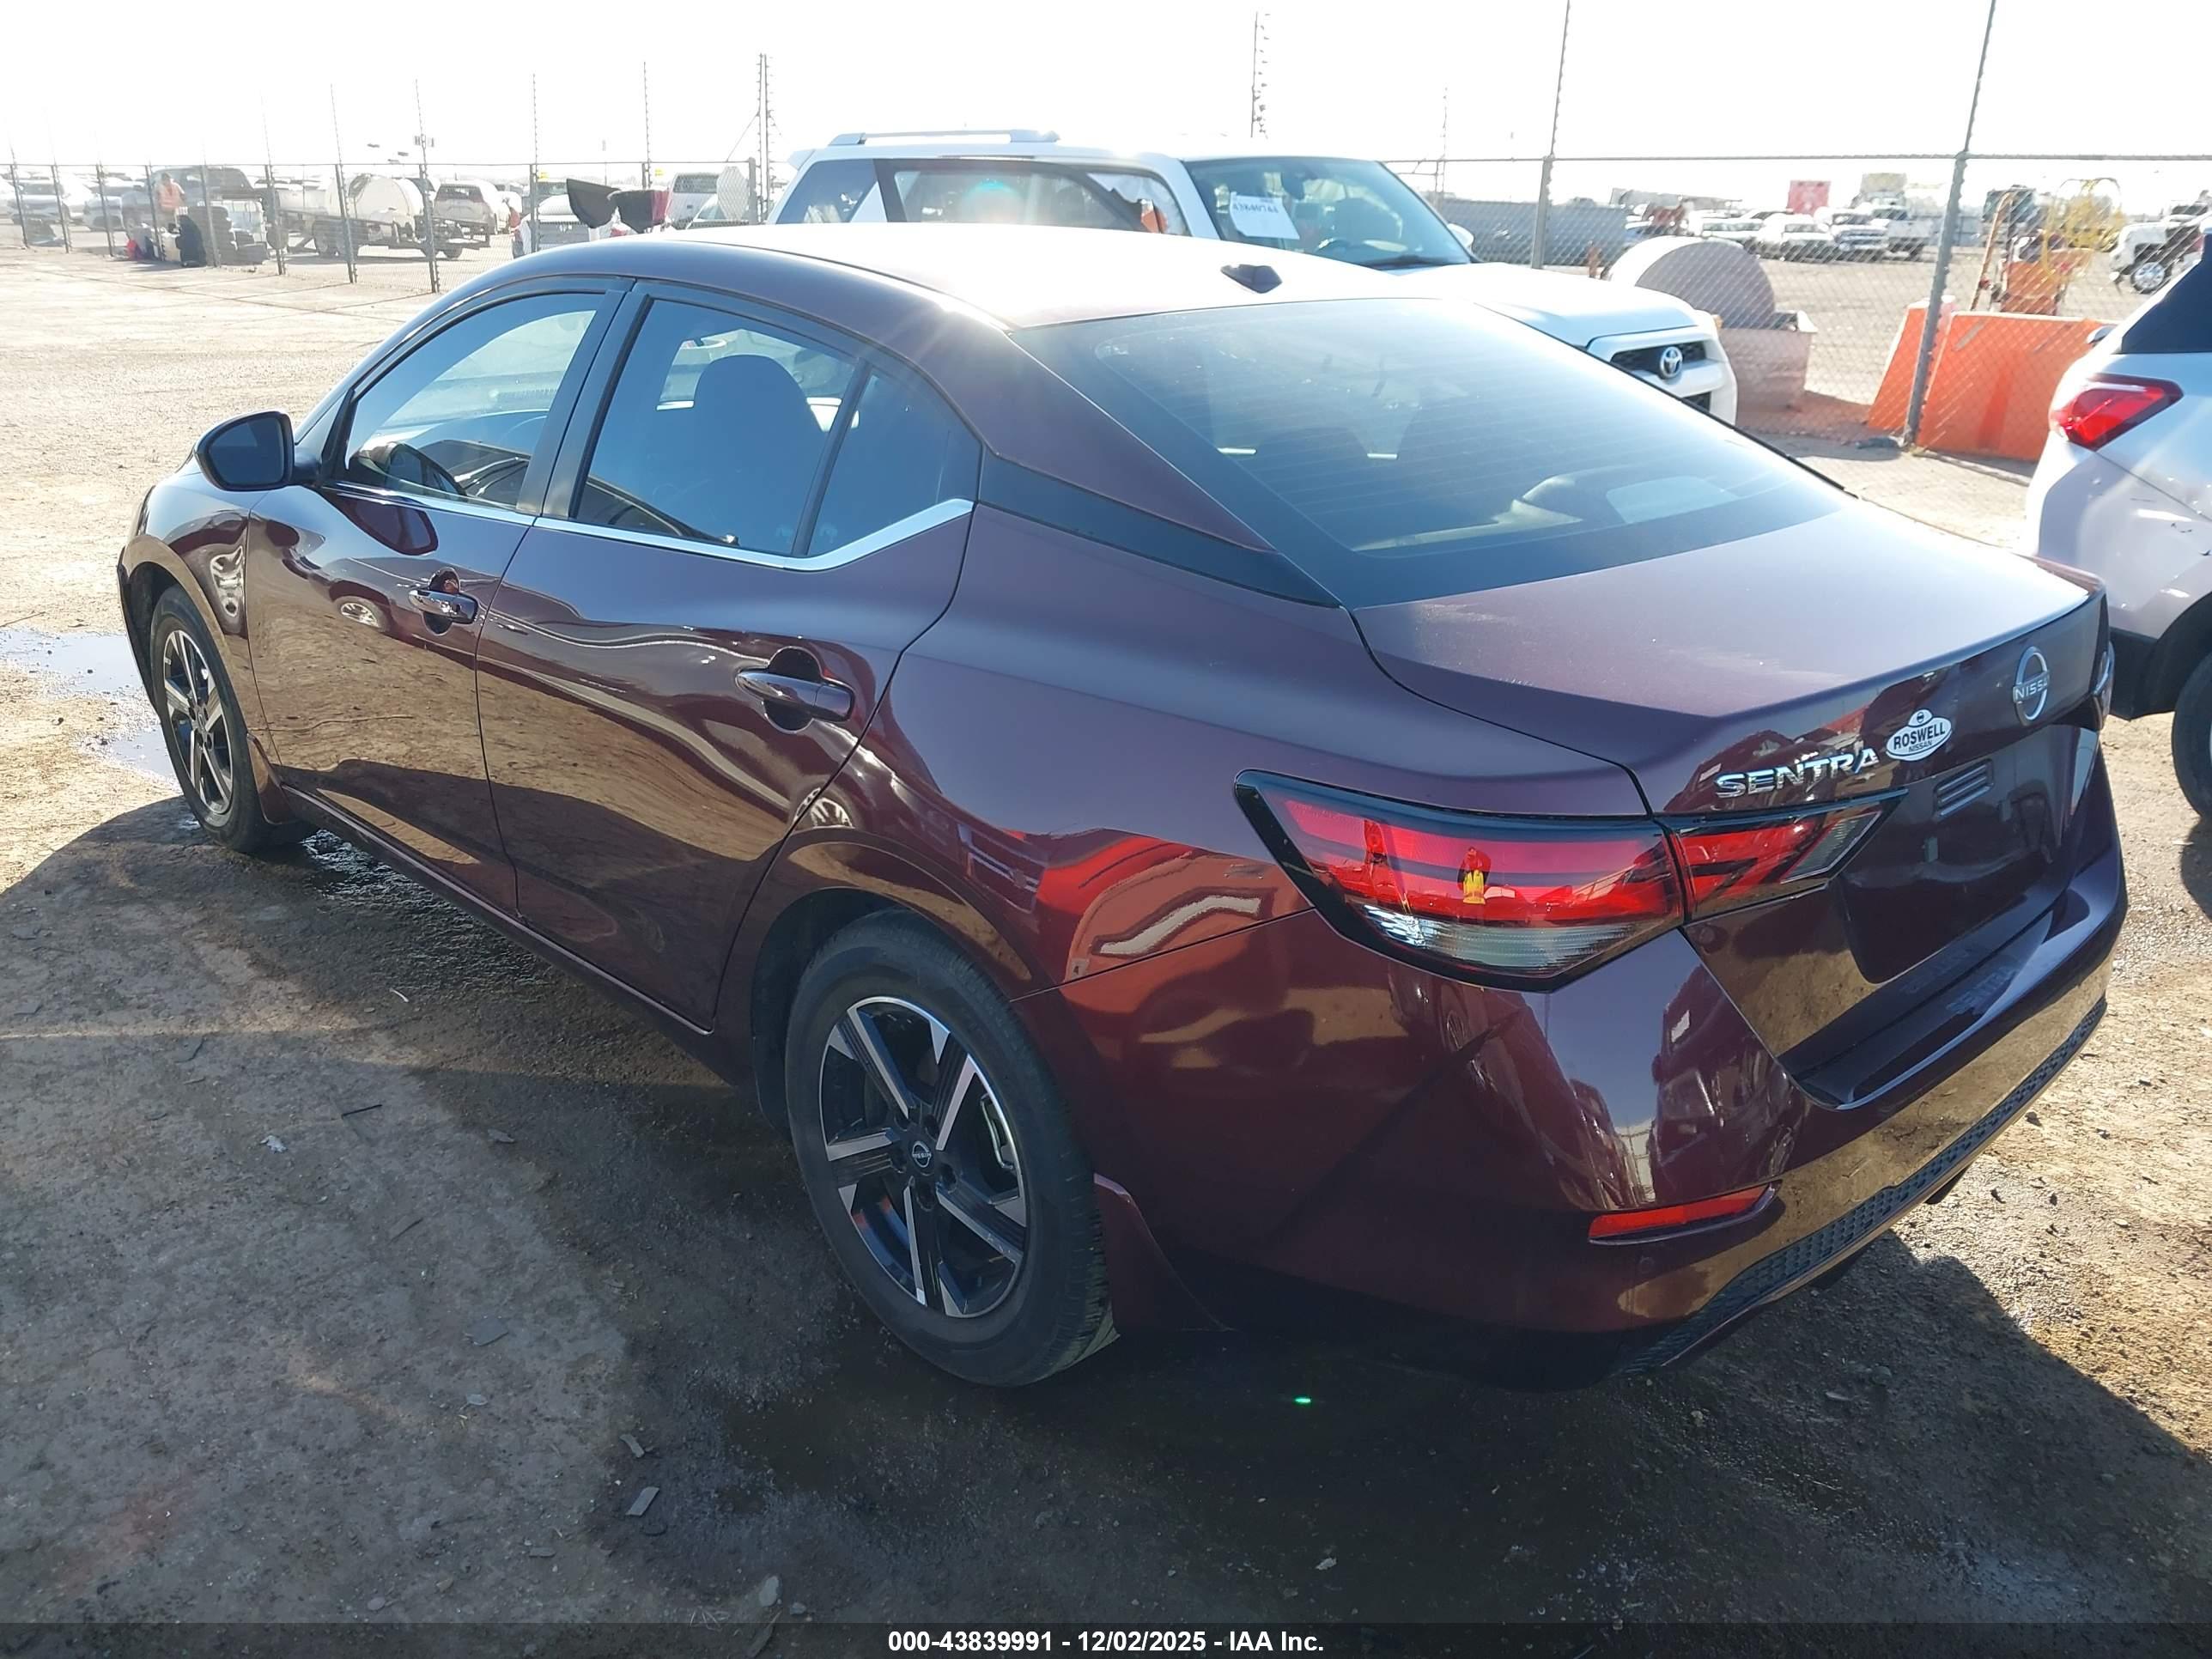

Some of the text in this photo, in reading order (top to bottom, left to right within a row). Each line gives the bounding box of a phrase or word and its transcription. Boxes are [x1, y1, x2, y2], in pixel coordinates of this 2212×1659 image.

[2015, 677, 2049, 700] NISS
[1893, 722, 1946, 750] ROSWELL
[1908, 740, 1933, 753] NISSAN
[1714, 748, 1880, 798] SENTRA
